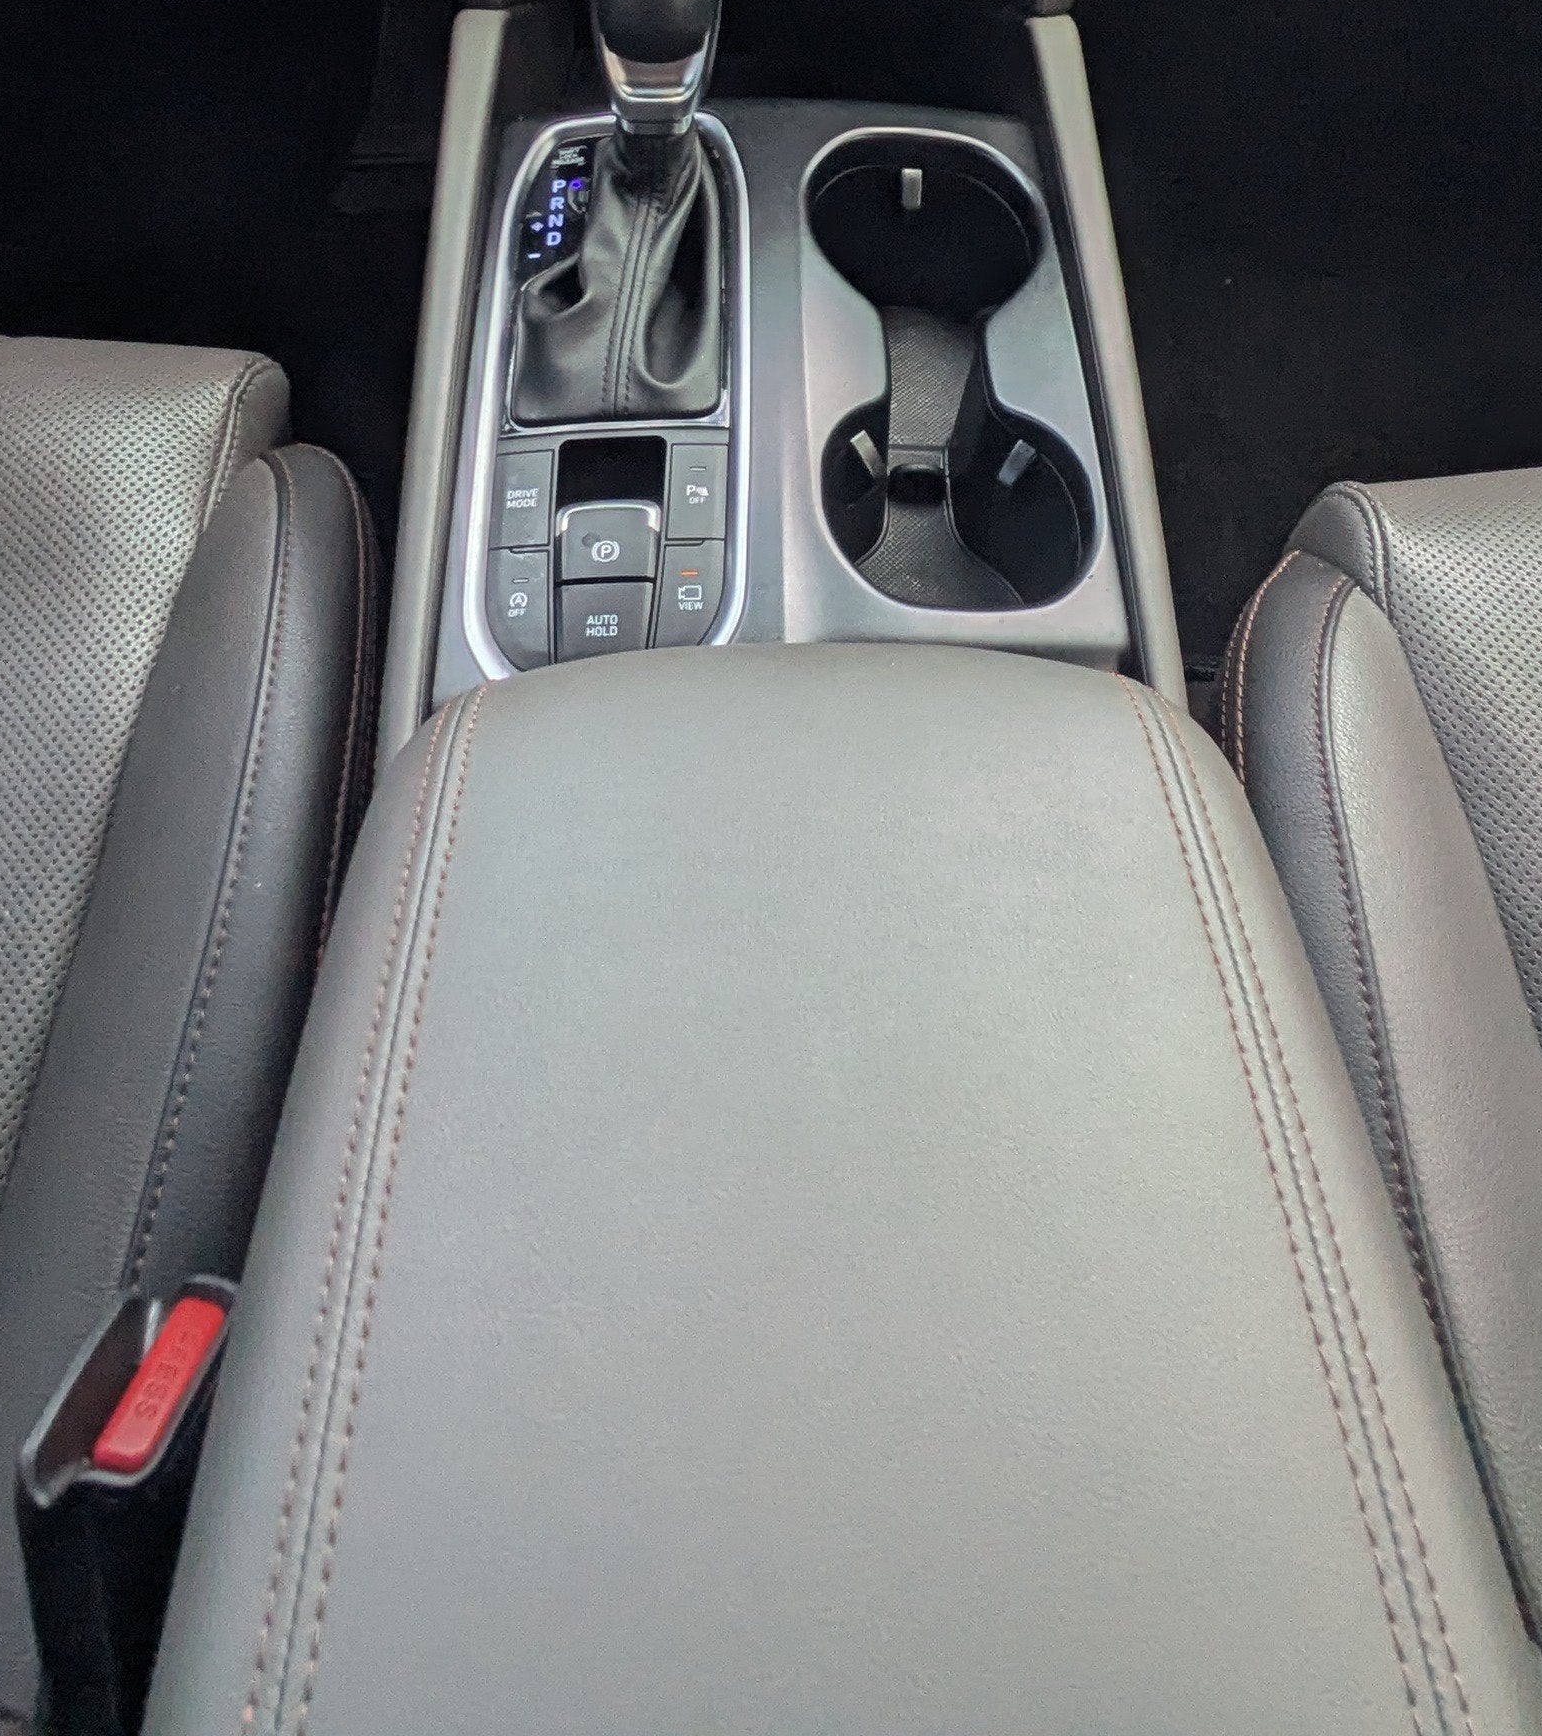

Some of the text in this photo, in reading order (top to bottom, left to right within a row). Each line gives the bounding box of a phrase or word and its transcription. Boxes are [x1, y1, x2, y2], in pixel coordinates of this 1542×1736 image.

[552, 179, 566, 193] P
[550, 196, 565, 211] R
[548, 213, 564, 228] N
[546, 231, 562, 246] D
[507, 488, 539, 499] DRIVE
[506, 498, 537, 509] MODE
[688, 496, 706, 504] OFF
[678, 601, 703, 611] VIEW
[507, 608, 527, 618] OFF
[586, 614, 618, 626] AUTO
[586, 625, 618, 637] HOLD
